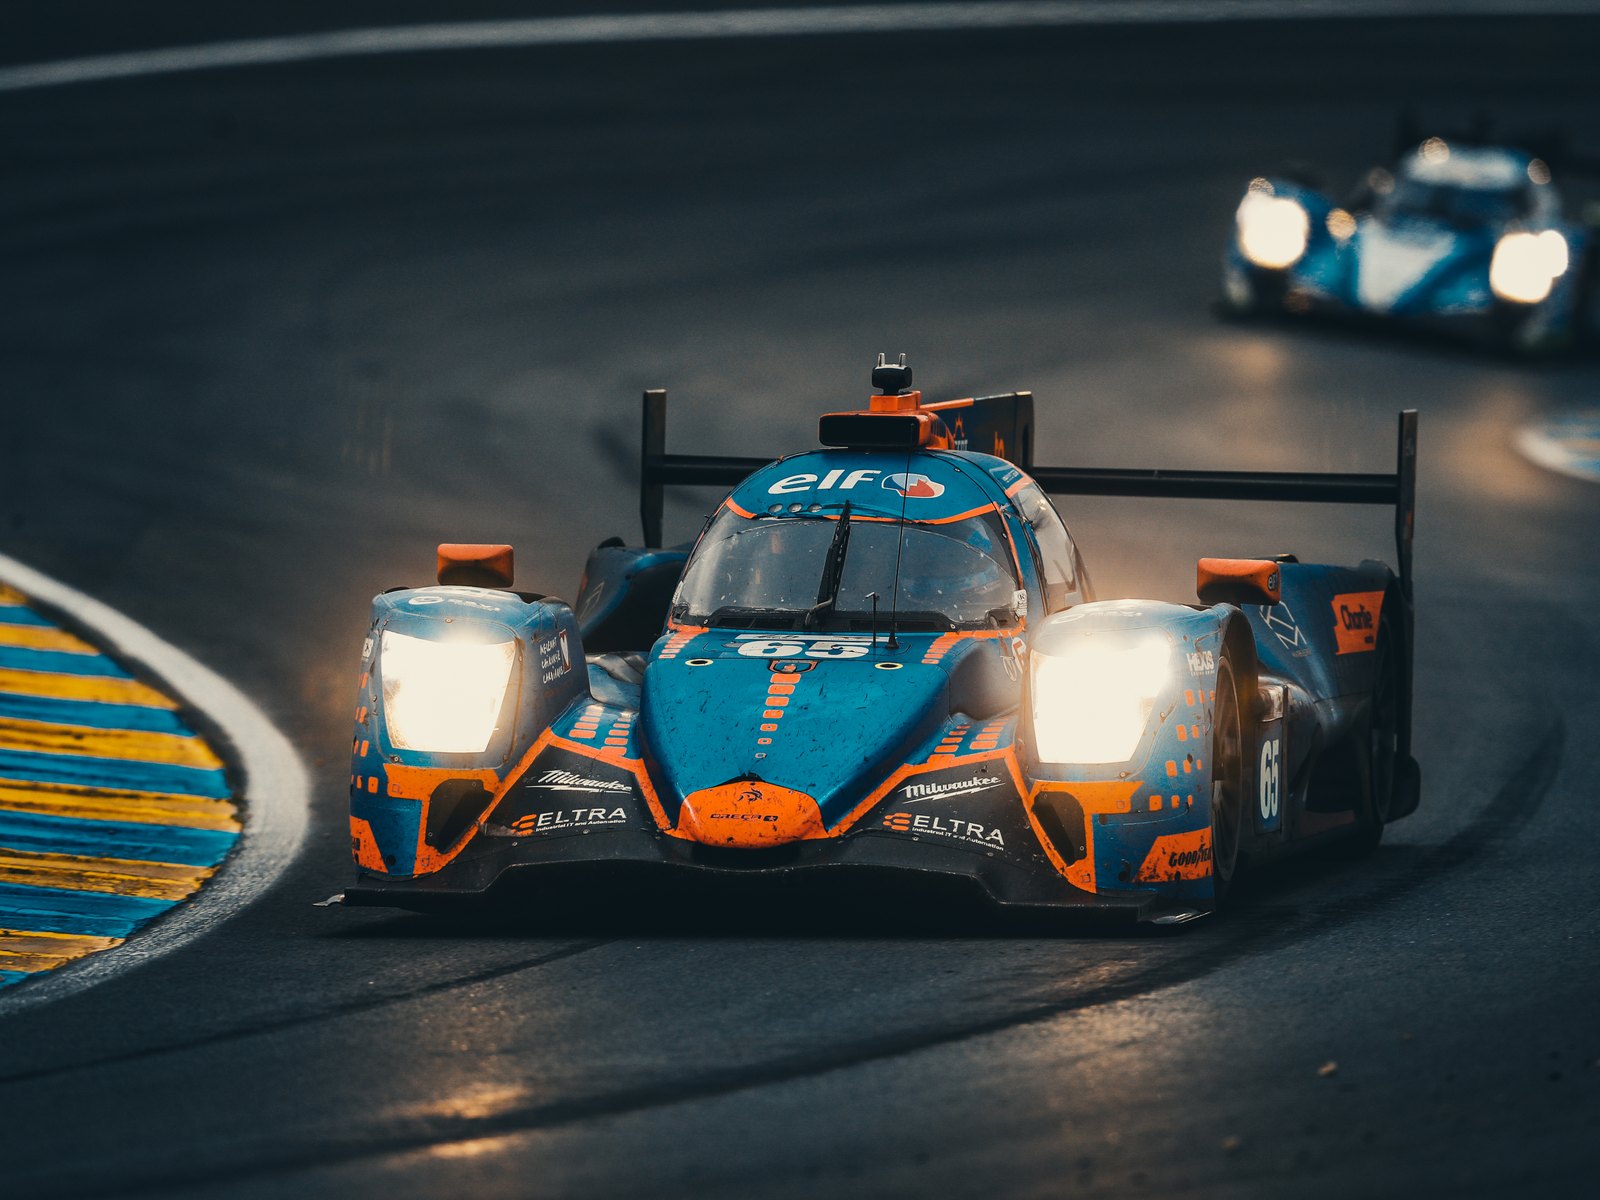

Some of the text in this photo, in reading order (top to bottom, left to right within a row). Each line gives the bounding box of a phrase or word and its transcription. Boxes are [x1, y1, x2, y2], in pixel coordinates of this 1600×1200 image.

[768, 469, 882, 494] elf
[738, 640, 870, 658] 65
[537, 769, 633, 792] Milwaukee
[898, 776, 1002, 798] Milwaukee
[1260, 739, 1280, 819] 65
[537, 807, 628, 827] ELTRA
[913, 814, 1006, 846] ELTRA
[966, 836, 1005, 851] Automation
